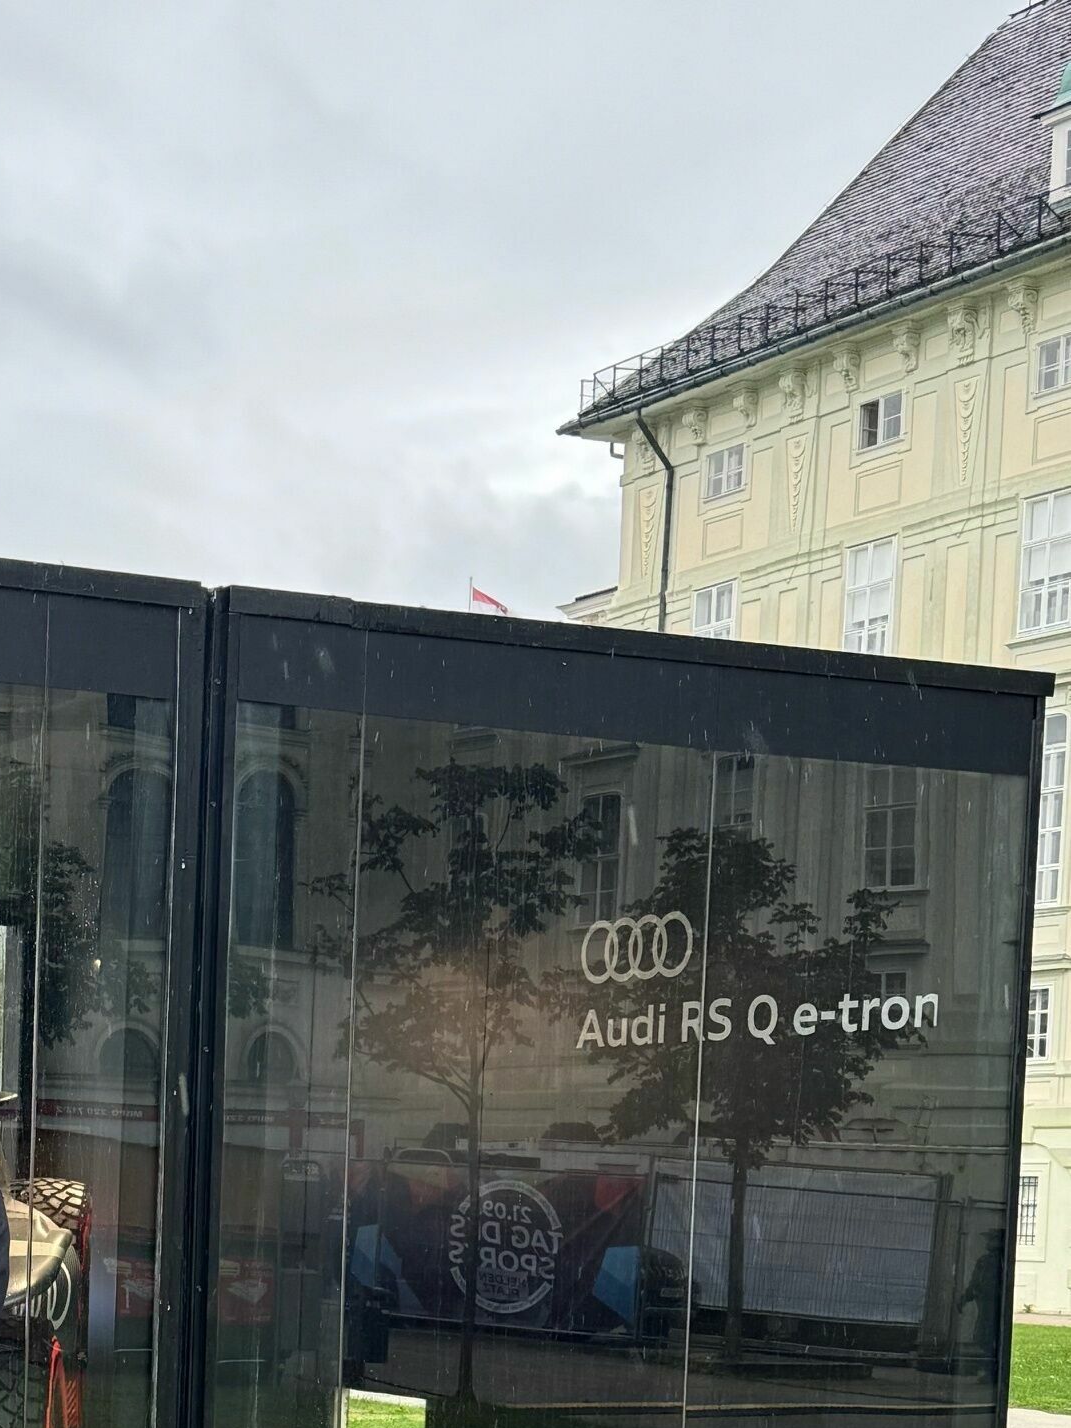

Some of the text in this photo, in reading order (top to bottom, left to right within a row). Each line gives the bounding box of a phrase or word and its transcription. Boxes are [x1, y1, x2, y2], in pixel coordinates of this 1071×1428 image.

[575, 992, 939, 1049] Audi RS Q e-tron
